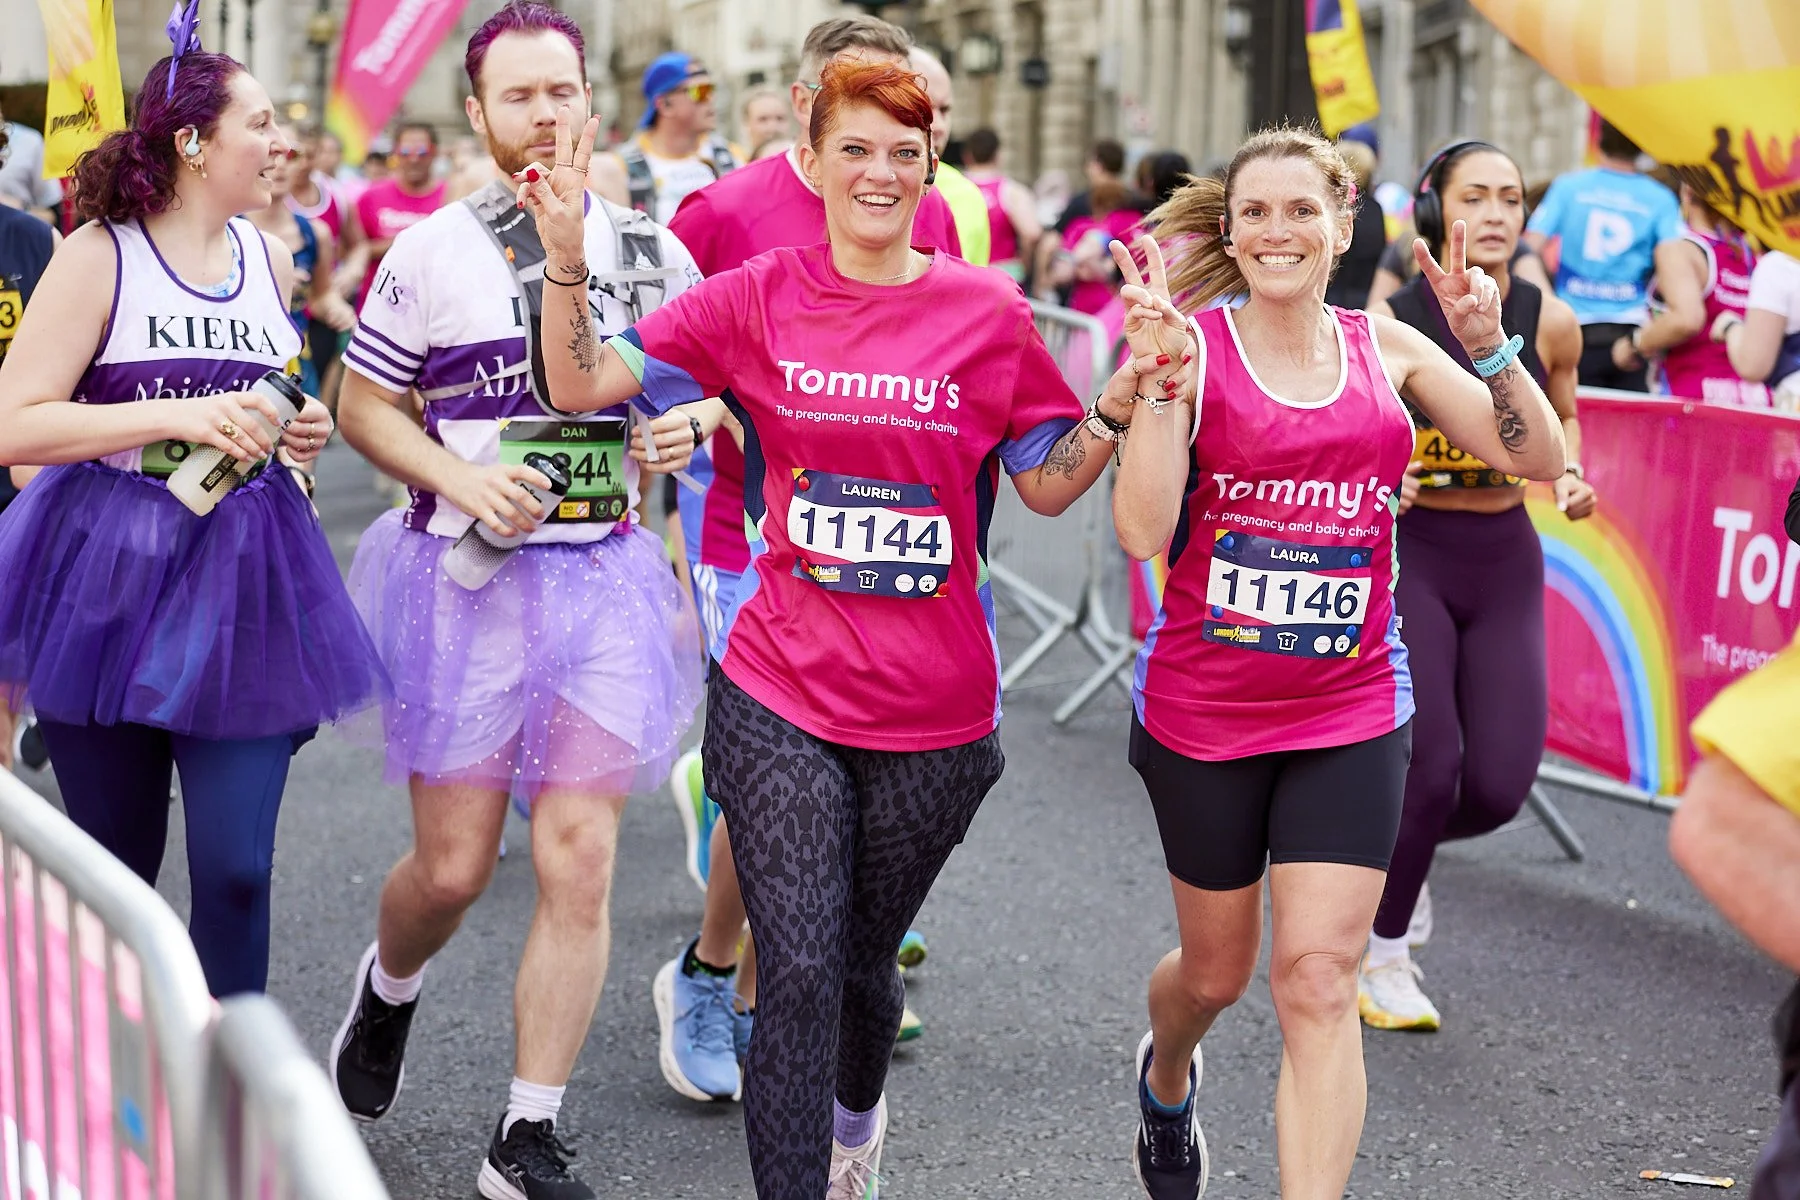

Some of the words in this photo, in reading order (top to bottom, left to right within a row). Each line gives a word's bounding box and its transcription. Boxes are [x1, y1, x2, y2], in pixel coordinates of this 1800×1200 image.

[144, 315, 281, 357] KIERA
[777, 359, 961, 414] Tommy's
[561, 427, 588, 438] DAN
[775, 404, 794, 418] The
[795, 408, 860, 426] pregnancy
[862, 413, 888, 425] and
[890, 414, 922, 431] baby
[924, 419, 959, 437] charity
[841, 482, 901, 502] LAUREN
[1212, 472, 1392, 519] Tommy's
[800, 507, 942, 558] 11144
[1201, 510, 1218, 521] he
[1221, 512, 1285, 532] pregnancy
[1288, 521, 1313, 533] and
[1315, 522, 1345, 538] baby
[1270, 547, 1320, 565] LAURA
[1222, 568, 1360, 619] 11146
[1702, 634, 1728, 666] The
